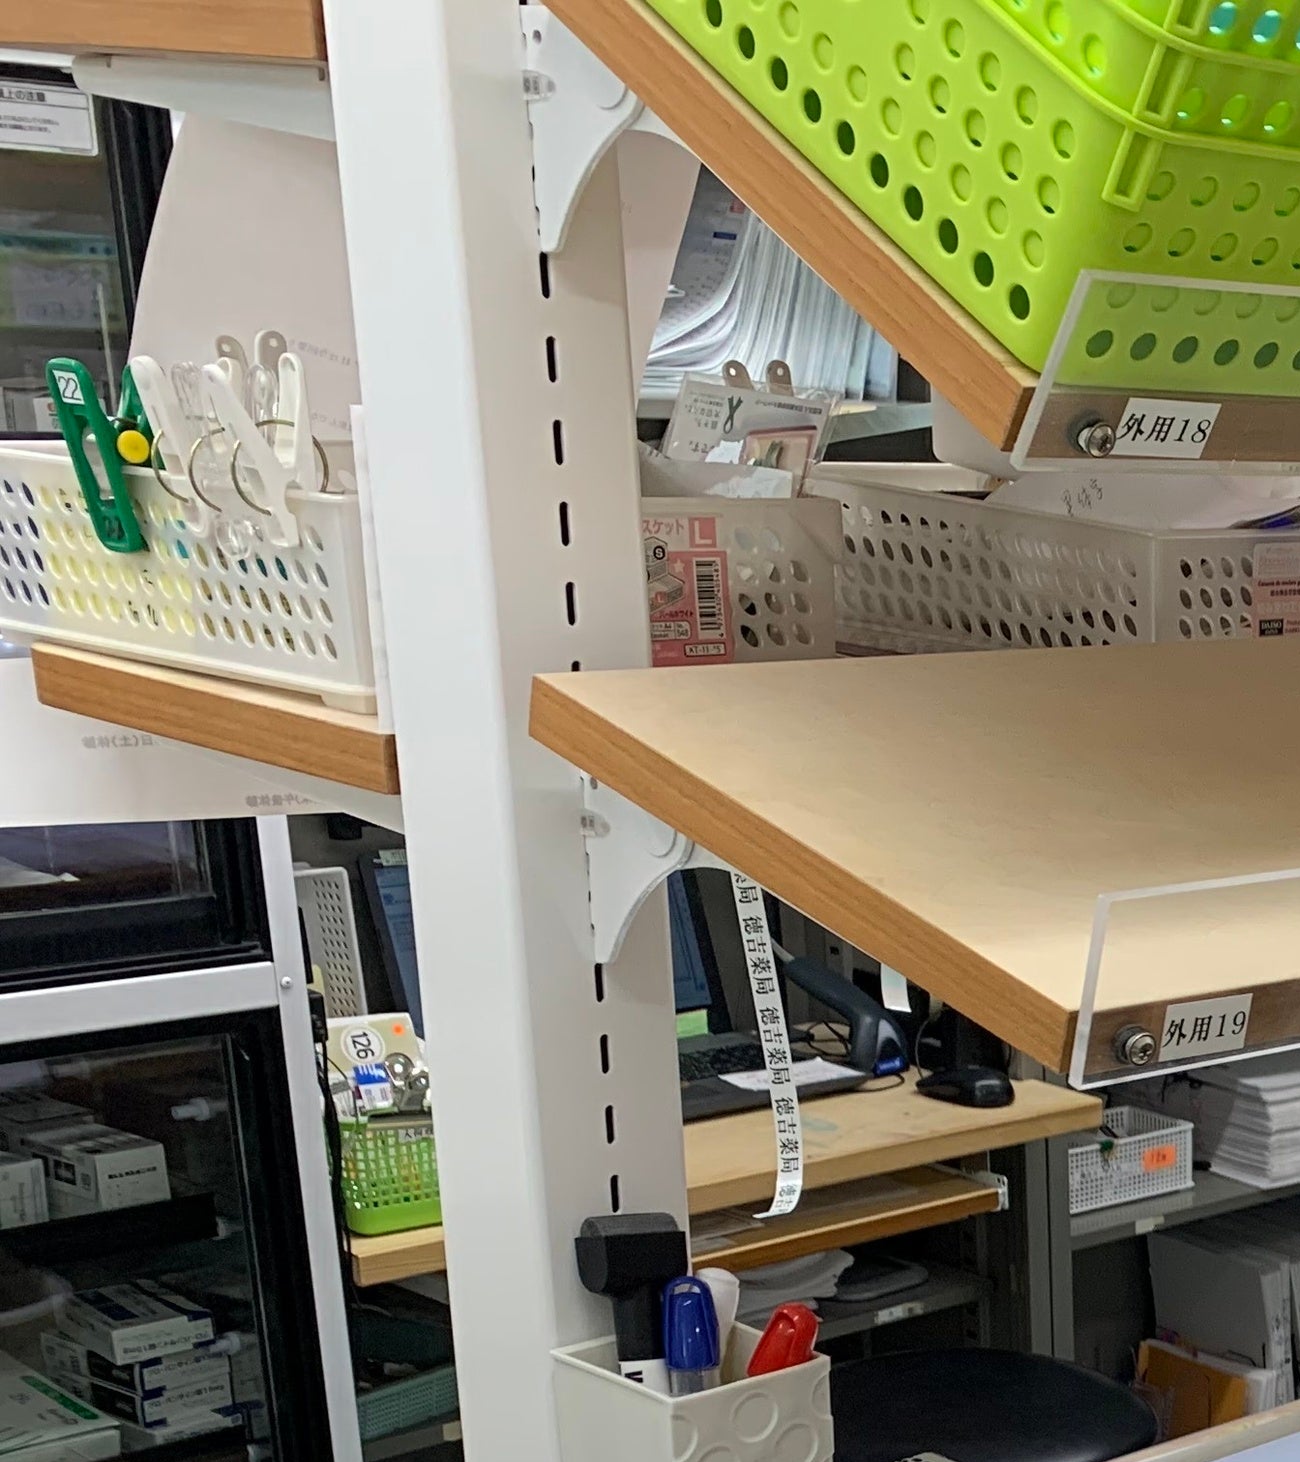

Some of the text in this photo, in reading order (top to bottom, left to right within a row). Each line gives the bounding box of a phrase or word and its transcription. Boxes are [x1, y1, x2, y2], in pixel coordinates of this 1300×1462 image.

[1117, 412, 1212, 444] 外用18
[742, 915, 776, 996] 徳吉薬局
[350, 1031, 375, 1060] 126
[759, 1005, 792, 1086] 徳吉薬局
[1162, 1010, 1247, 1048] 外用19
[775, 1095, 800, 1174] 徳吉薬局
